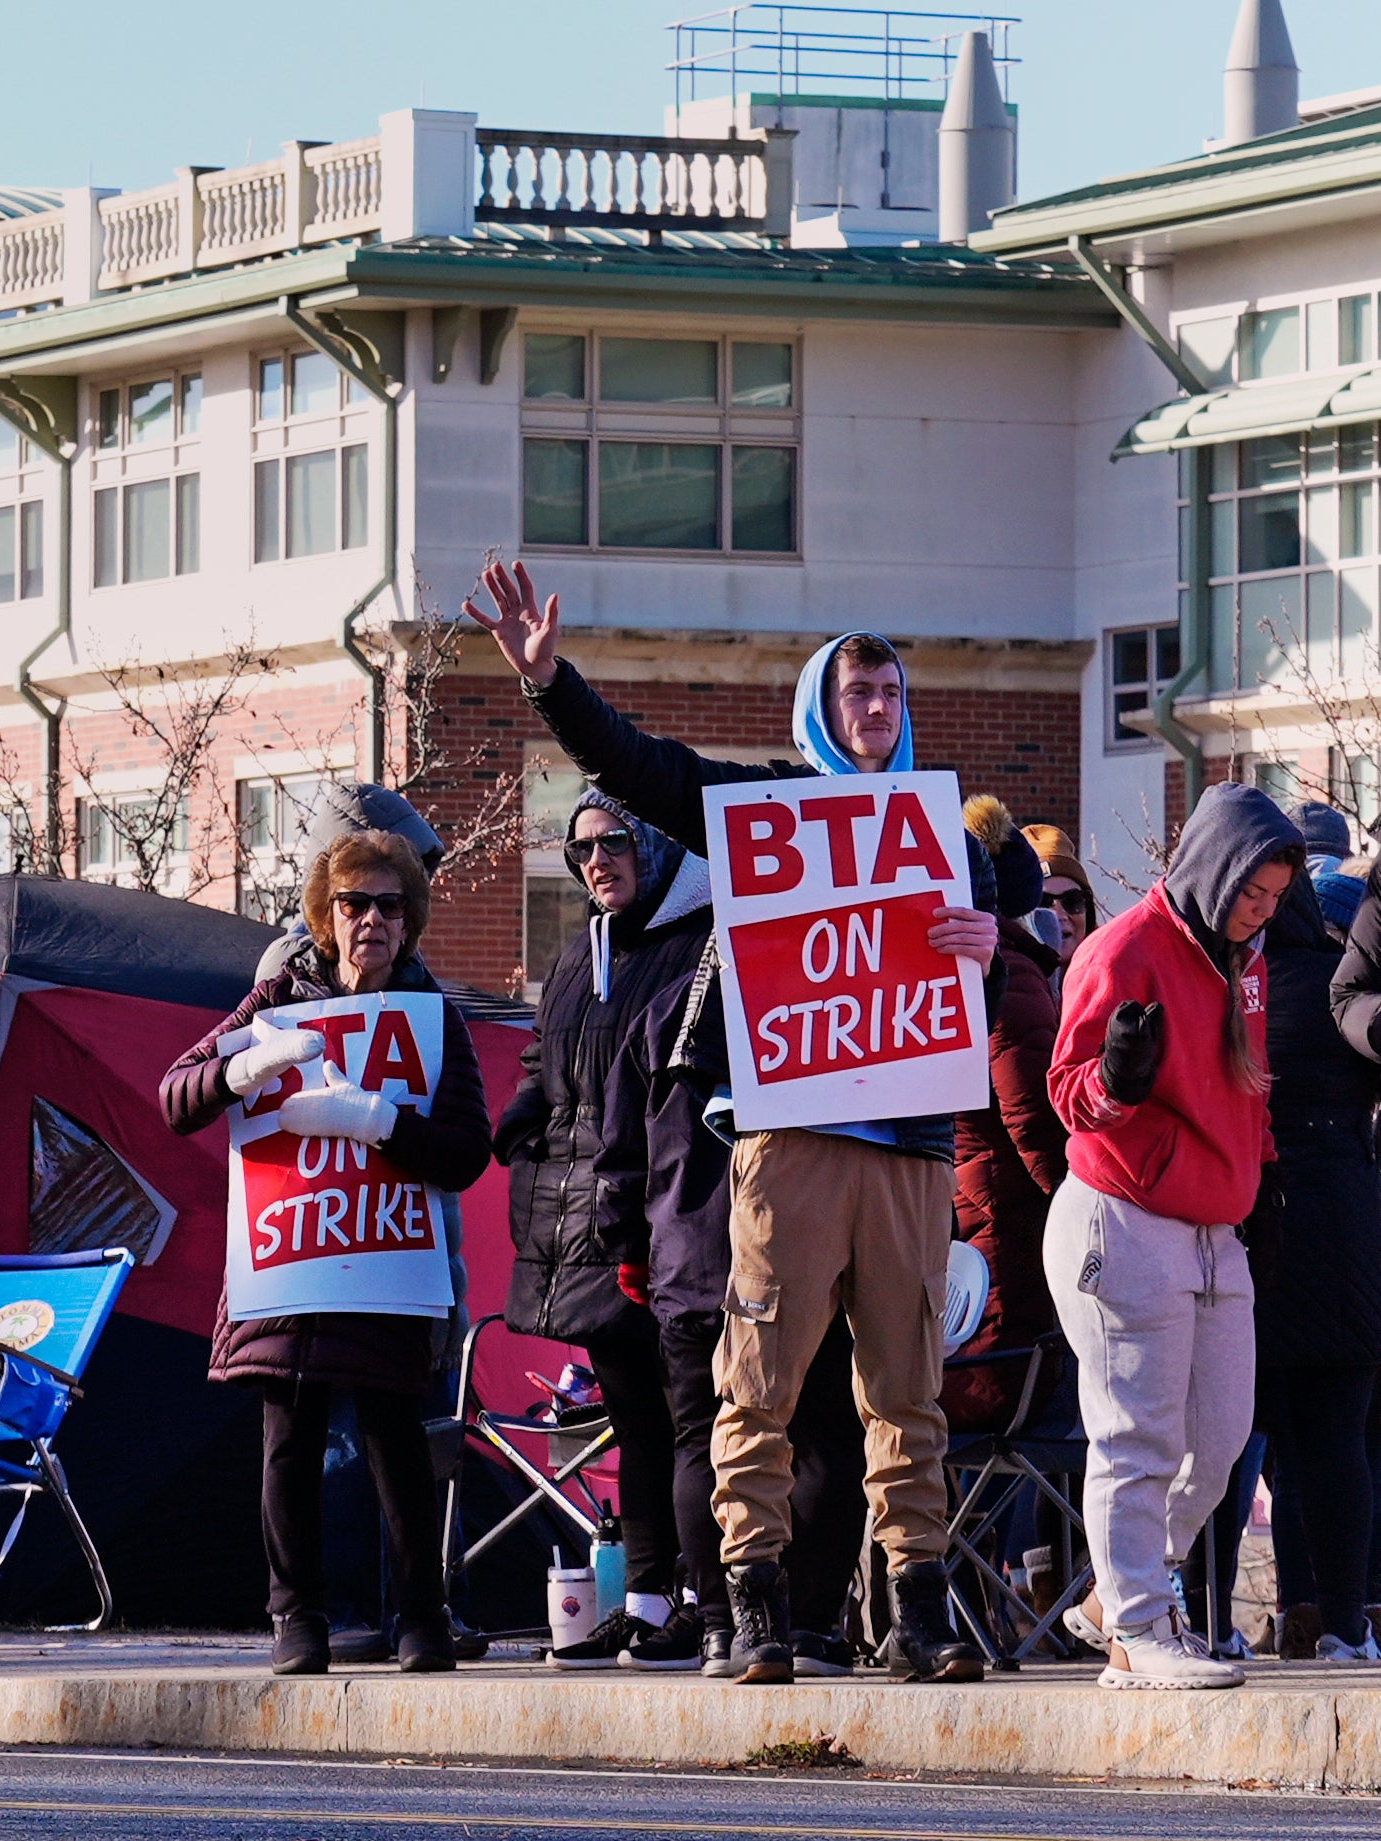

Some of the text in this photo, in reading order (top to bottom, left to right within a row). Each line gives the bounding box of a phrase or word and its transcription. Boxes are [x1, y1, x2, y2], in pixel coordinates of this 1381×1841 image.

[724, 793, 955, 897] BTA
[802, 908, 883, 983] ON
[758, 975, 957, 1072] STRIKE
[298, 1136, 367, 1179] ON
[255, 1182, 424, 1261] STRIKE
